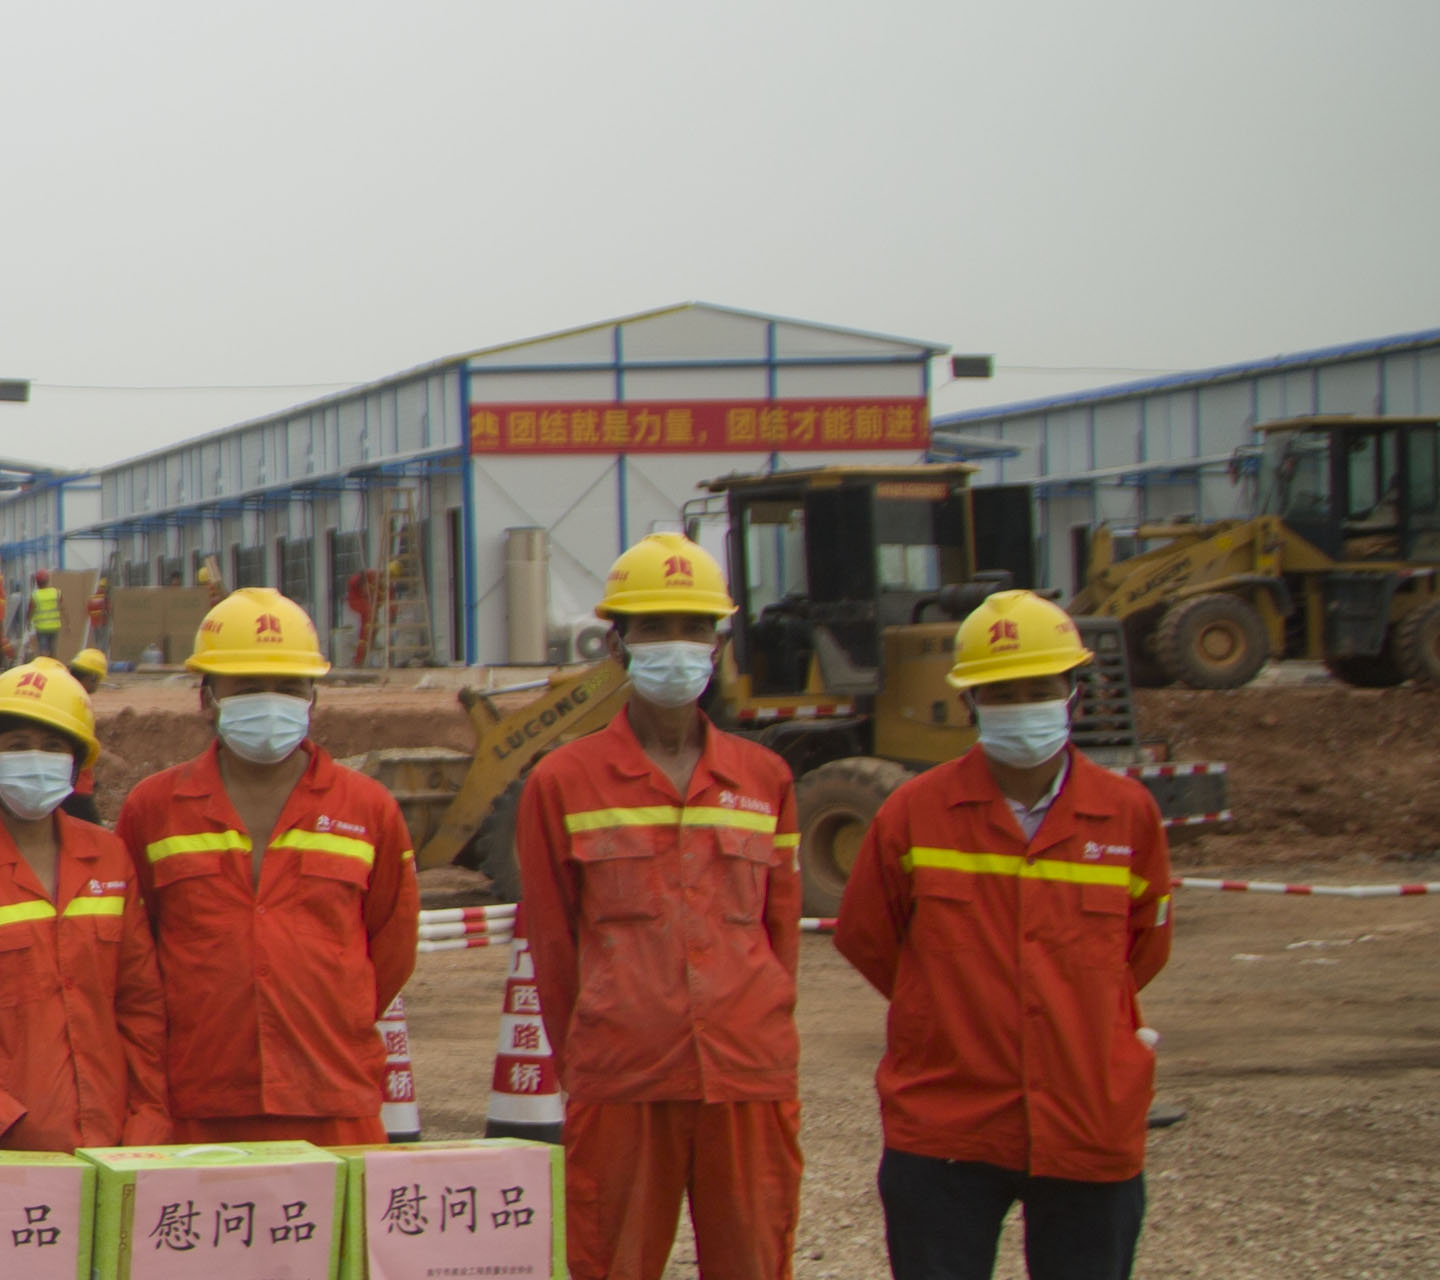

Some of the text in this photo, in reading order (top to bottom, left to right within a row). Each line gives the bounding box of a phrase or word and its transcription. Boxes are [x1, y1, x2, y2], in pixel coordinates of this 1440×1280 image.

[149, 1201, 316, 1251] 慰问品
[382, 1184, 534, 1235] 慰问品
[426, 1265, 534, 1277] 南宁市建设工程质量安全协会
